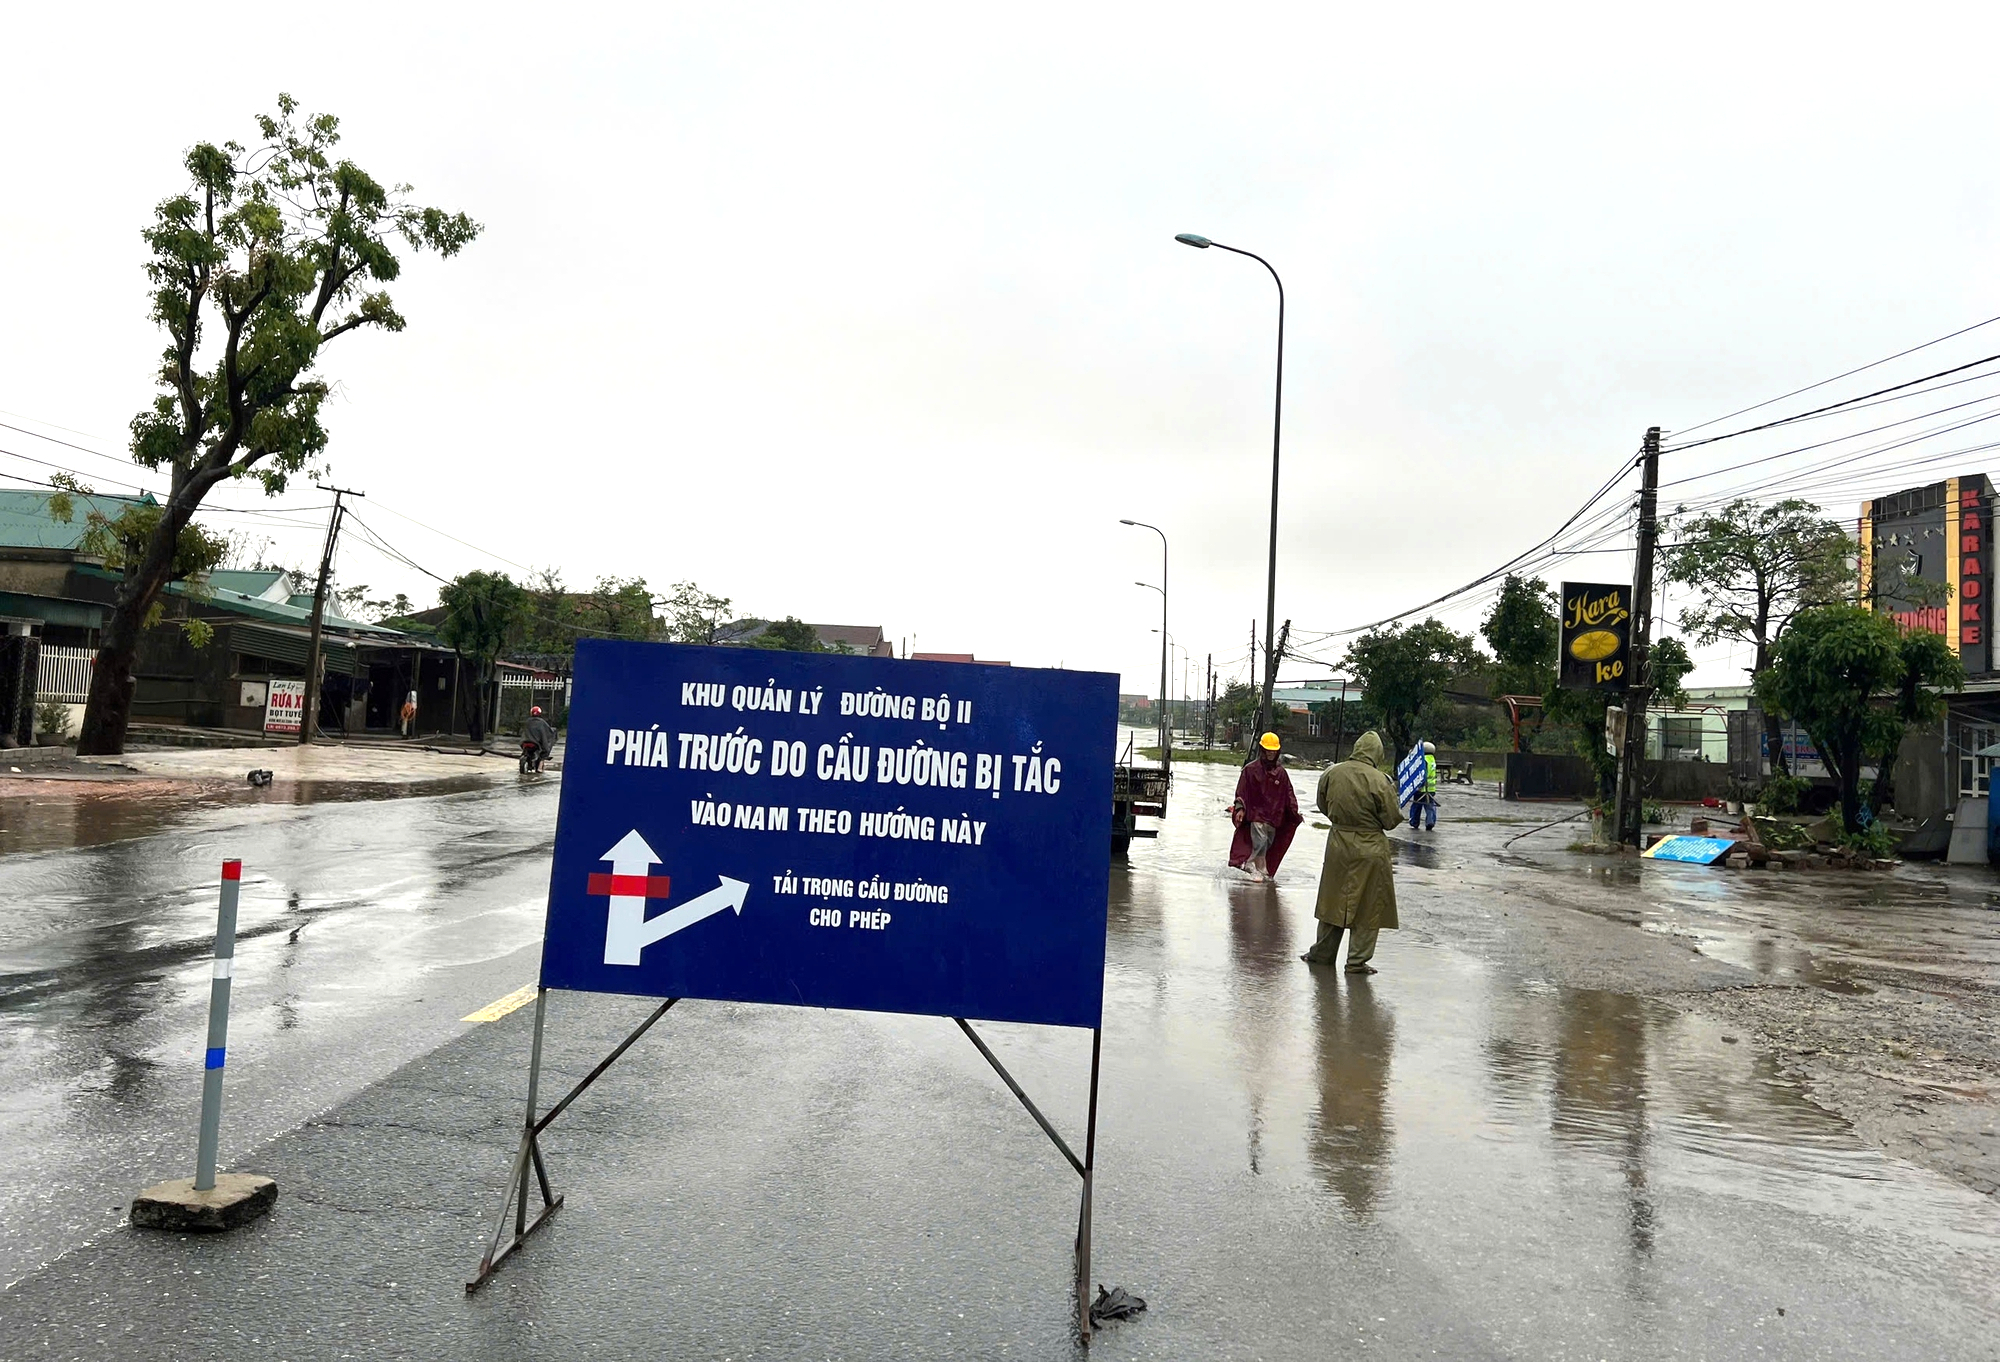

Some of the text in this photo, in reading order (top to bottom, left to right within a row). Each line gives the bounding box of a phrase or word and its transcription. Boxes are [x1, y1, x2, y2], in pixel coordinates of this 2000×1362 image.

[1962, 489, 1981, 644] KARAOKE
[1565, 590, 1621, 629] Kara
[1596, 660, 1624, 684] ke
[271, 689, 303, 709] RỬA X
[285, 709, 302, 718] TUYẾ
[681, 678, 972, 730] KHU QUẢN LÝ ĐƯỜNG BỘ II
[607, 724, 668, 768] PHÍA
[678, 726, 762, 775] TRƯỚC
[771, 740, 806, 777] DO
[817, 732, 870, 782] CẦU
[877, 739, 967, 789] ĐƯỜNG
[975, 754, 1002, 799] BỊ
[1012, 741, 1061, 794] TẮC
[692, 793, 986, 845] VÀO NAM THEO HƯỚNG NÀY
[774, 870, 949, 904] TẢI TRỌNG CẦU ĐƯỜNG
[810, 908, 891, 930] CHO PHÉP
